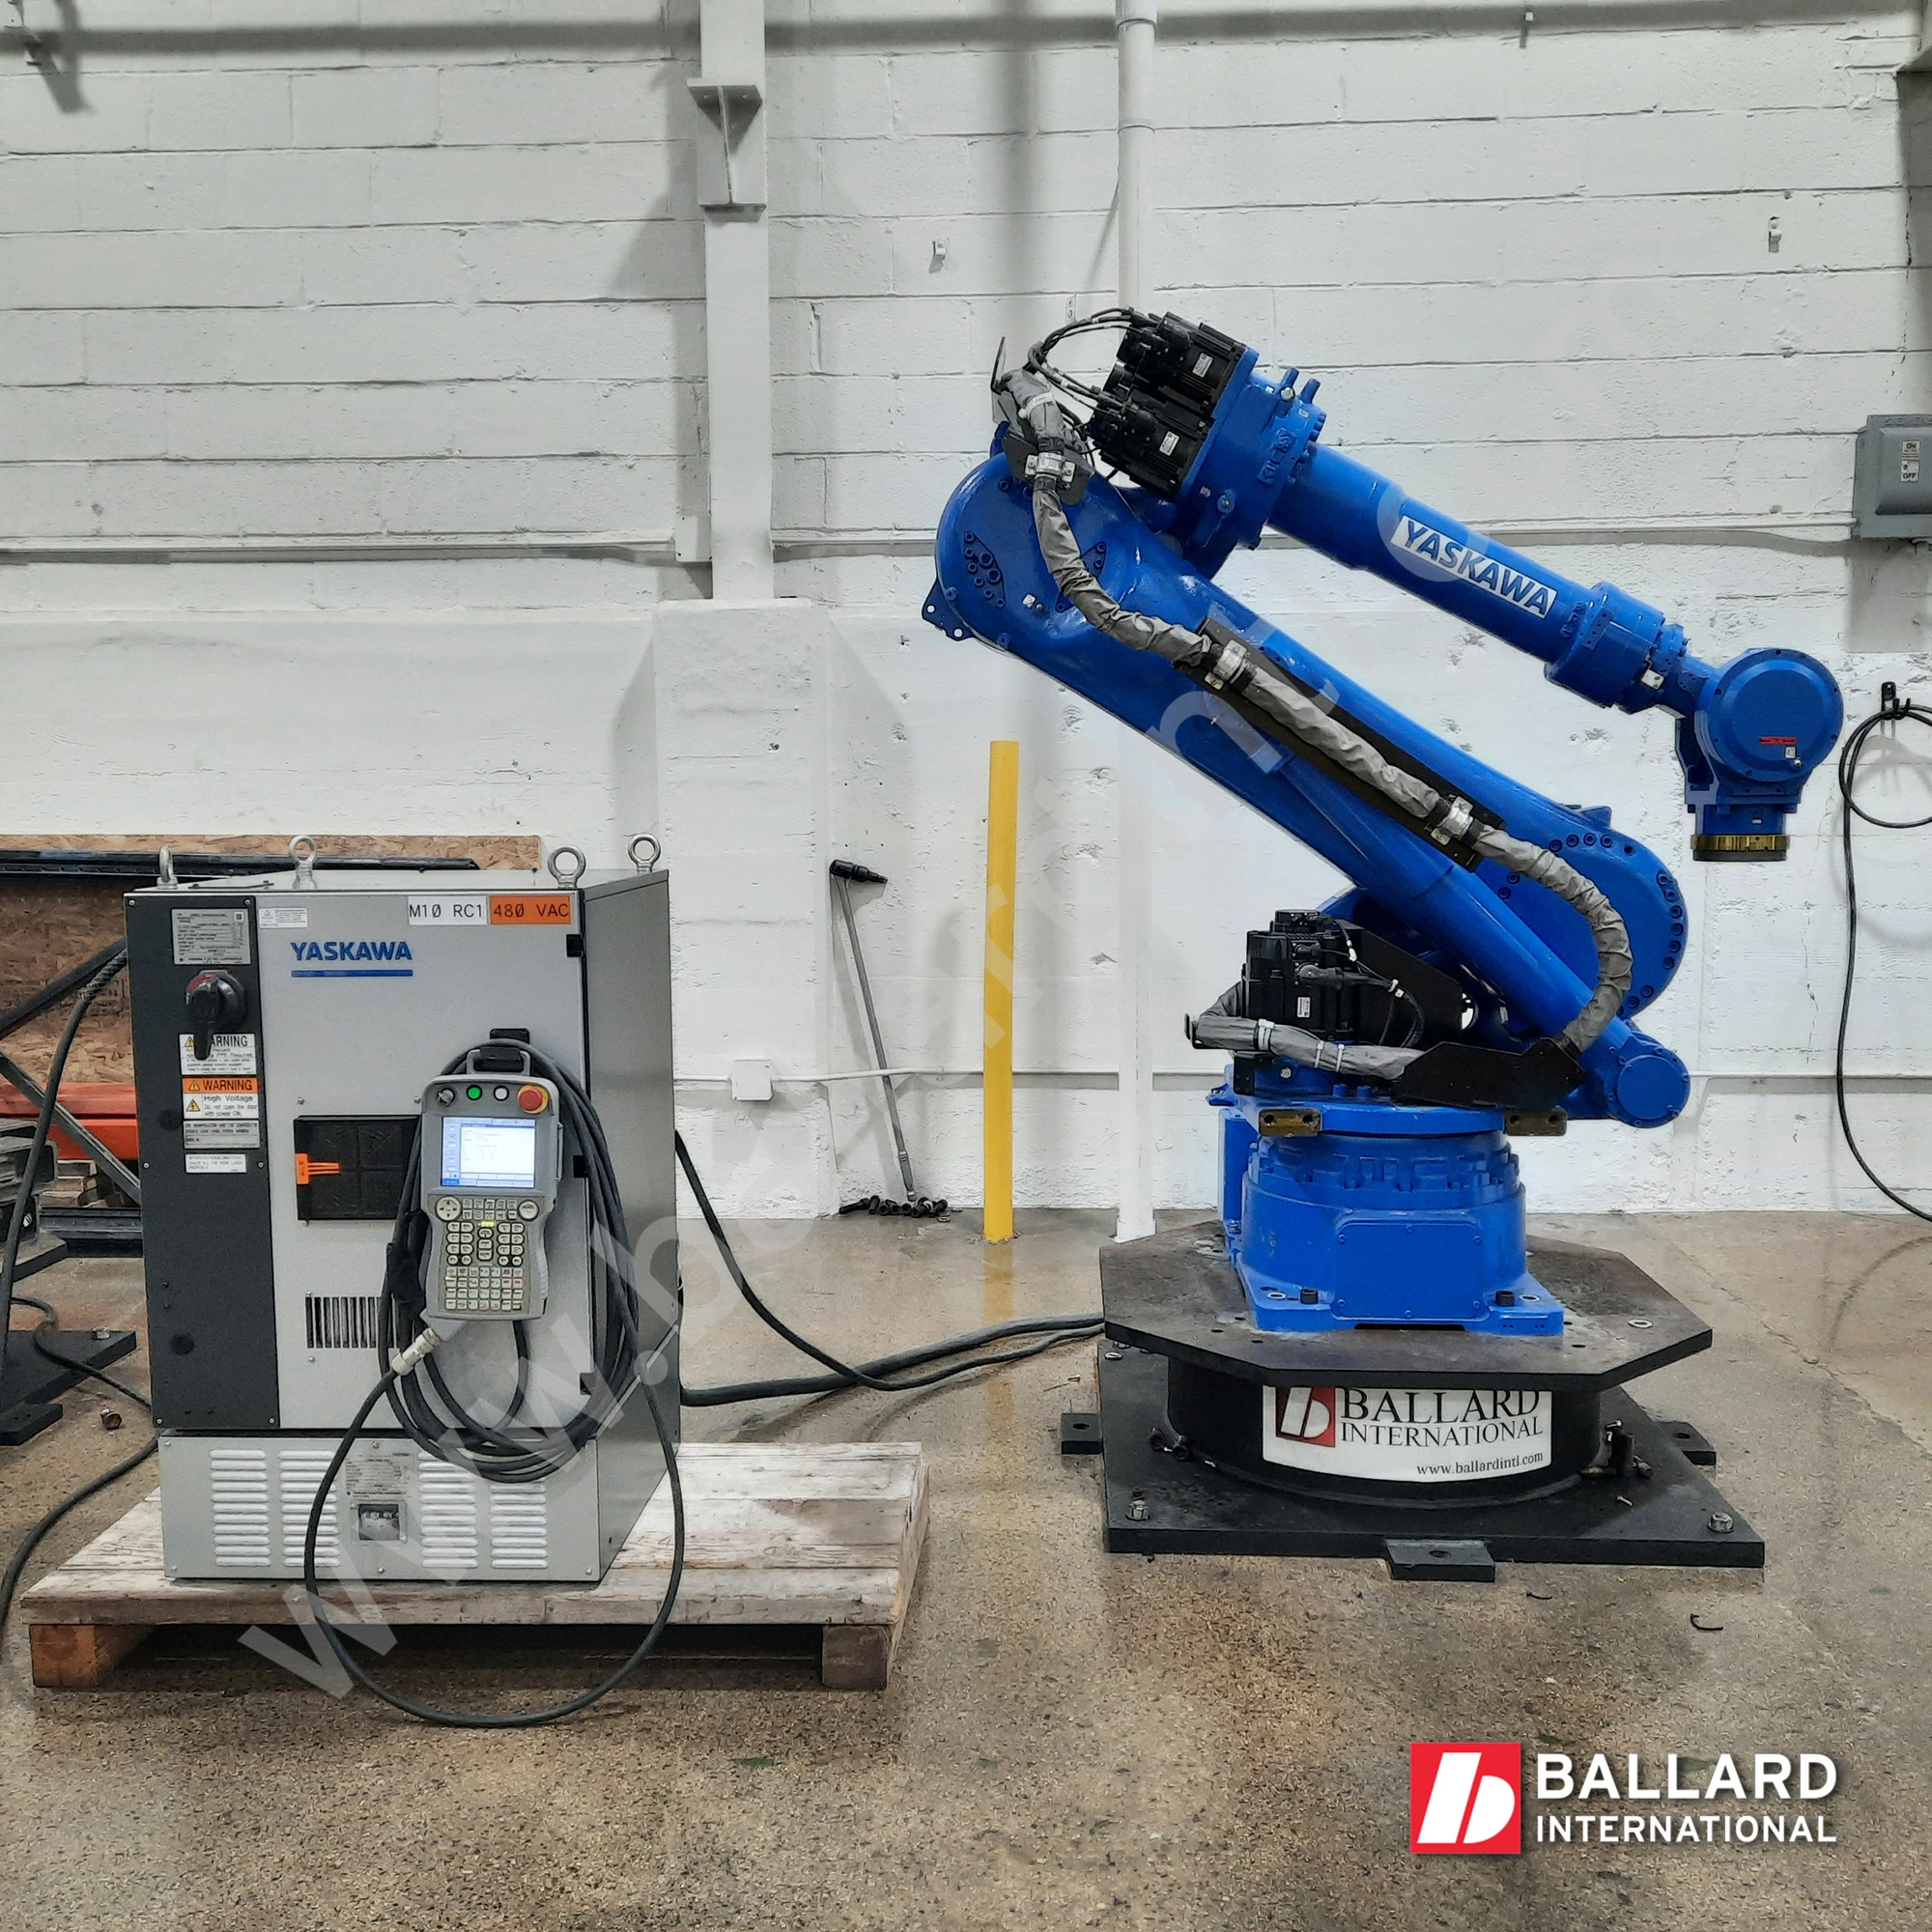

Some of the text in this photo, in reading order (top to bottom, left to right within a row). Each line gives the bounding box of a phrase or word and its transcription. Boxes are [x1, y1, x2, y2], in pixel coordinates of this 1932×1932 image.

[1404, 521, 1550, 614] YASKAWA
[453, 904, 483, 918] RC1
[537, 903, 569, 917] VAC
[291, 941, 413, 961] YASKAWA
[203, 1079, 253, 1091] WARNING
[204, 1094, 253, 1103] High Voltage
[1341, 1389, 1540, 1424] BALLARD
[1340, 1416, 1544, 1447] INTERNATIONAL
[1416, 1452, 1544, 1475] www.ballardintl.com
